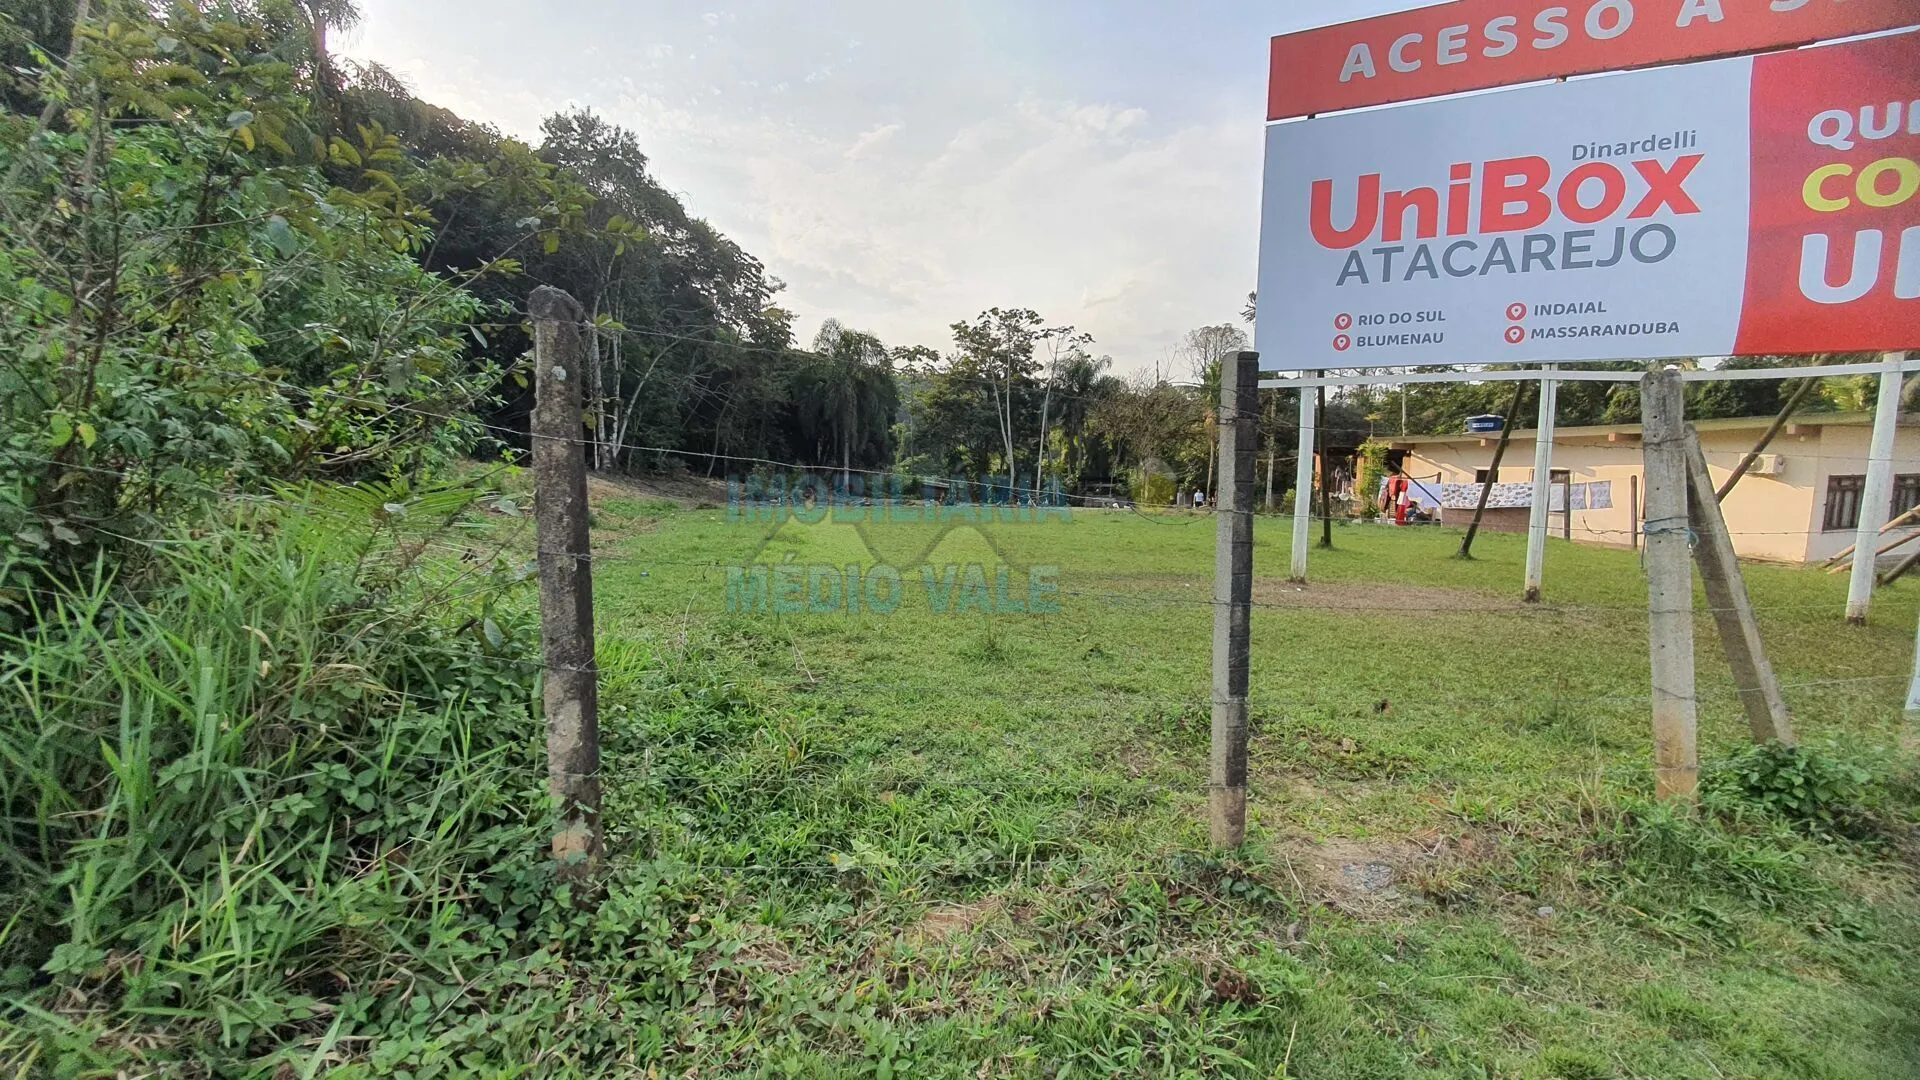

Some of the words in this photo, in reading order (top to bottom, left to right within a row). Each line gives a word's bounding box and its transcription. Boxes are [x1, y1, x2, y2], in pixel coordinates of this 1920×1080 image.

[1339, 0, 1634, 83] ACESSO
[1571, 129, 1697, 161] Dinardelli
[1335, 223, 1677, 287] ATACAREJO
[1357, 312, 1385, 327] RIO
[1388, 311, 1412, 325] DO
[1415, 310, 1447, 323] SUL
[1533, 301, 1608, 317] INDAIAL
[1355, 332, 1445, 348] BLUMENAU
[1530, 321, 1681, 340] MASSARANDUBA
